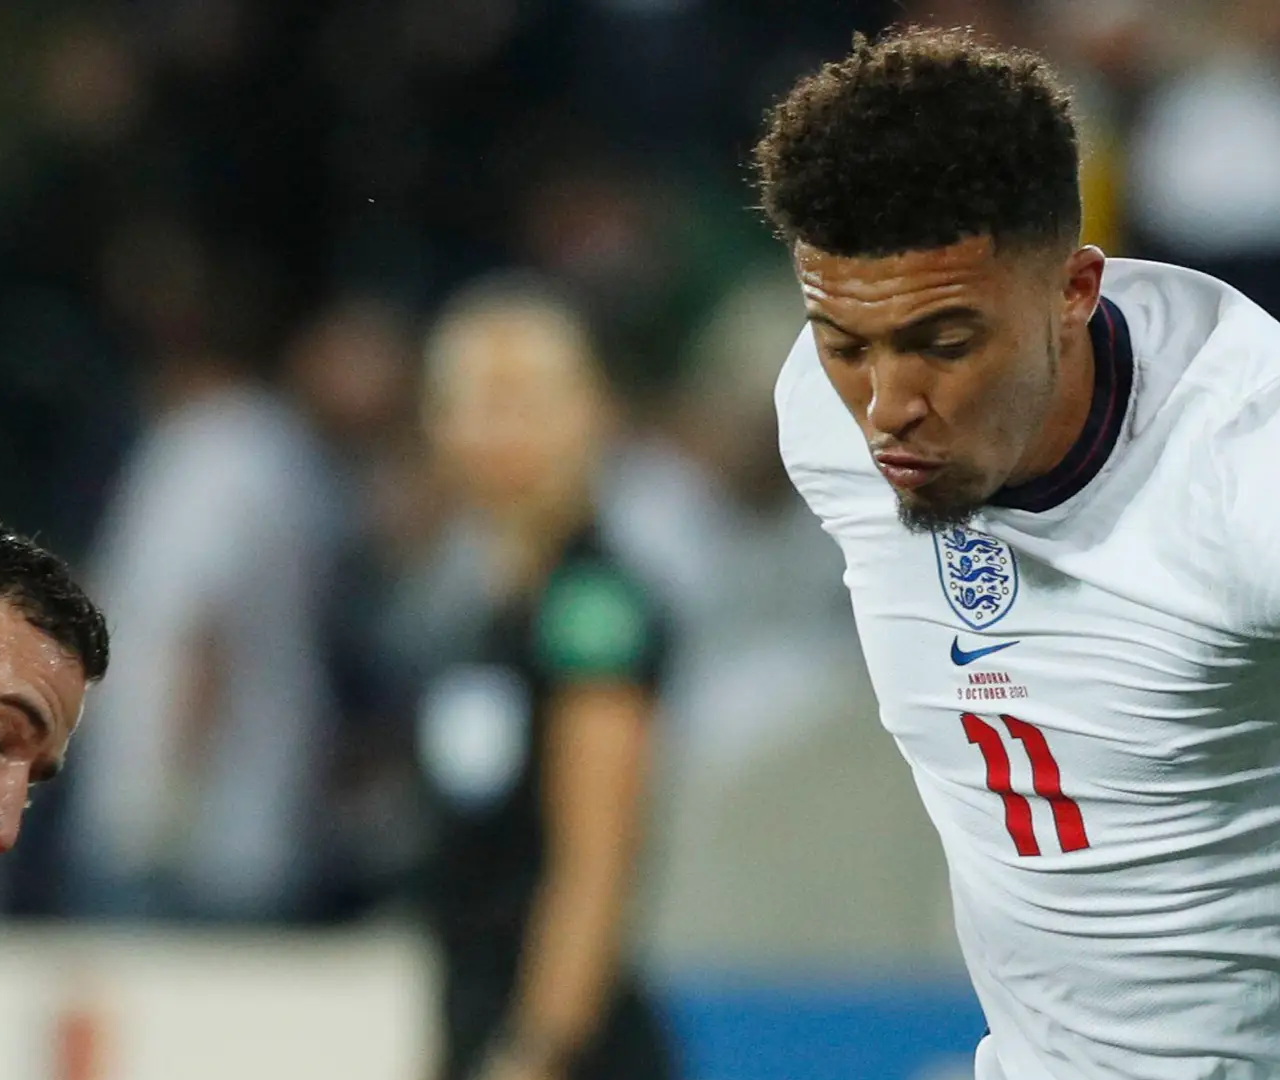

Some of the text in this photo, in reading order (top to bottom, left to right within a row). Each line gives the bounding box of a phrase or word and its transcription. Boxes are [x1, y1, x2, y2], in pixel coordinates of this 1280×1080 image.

[968, 672, 1011, 685] ANDORRA
[966, 687, 1007, 700] OCTOBER
[1009, 685, 1028, 698] 2021
[960, 712, 1090, 856] 11
